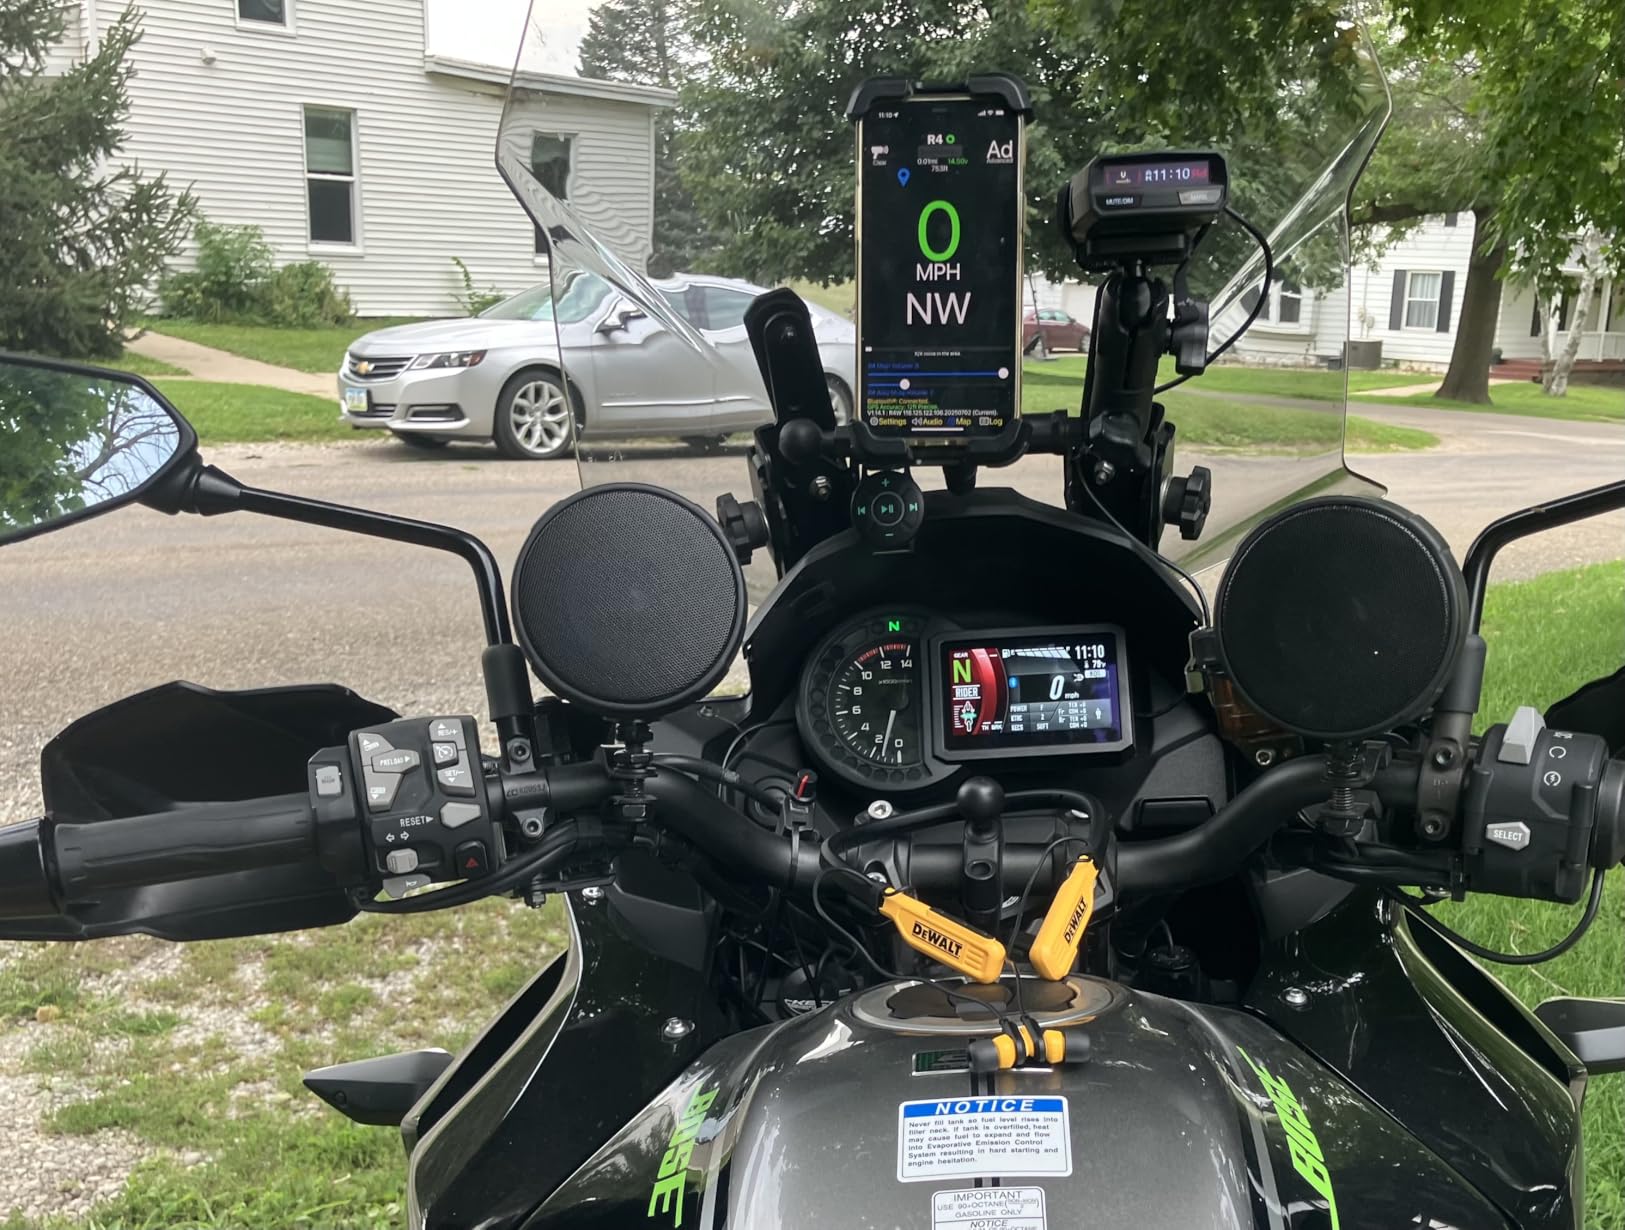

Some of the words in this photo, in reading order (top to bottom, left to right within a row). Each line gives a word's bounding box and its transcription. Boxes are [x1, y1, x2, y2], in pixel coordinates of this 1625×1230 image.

[927, 134, 944, 145] R4
[986, 139, 1013, 159] Ad
[918, 200, 961, 262] 0
[916, 263, 961, 281] MPH
[906, 292, 972, 325] NW
[879, 417, 907, 426] Settings
[922, 417, 943, 425] Audio
[955, 418, 972, 426] Map
[989, 418, 1003, 426] Log
[888, 621, 900, 632] N
[1075, 644, 1105, 659] 11:10
[880, 661, 892, 669] 12
[901, 660, 912, 668] 14
[861, 671, 873, 680] 10
[953, 659, 971, 684] N
[853, 687, 862, 696] 8
[1049, 675, 1065, 700] 0
[955, 687, 979, 698] RIDER
[1064, 692, 1080, 700] mph
[852, 706, 861, 714] 6
[861, 723, 870, 731] 4
[875, 735, 883, 744] 2
[895, 739, 903, 748] 0
[380, 758, 404, 767] PRELOAD
[400, 816, 426, 826] RESET
[1493, 830, 1523, 841] SELECT
[935, 1099, 1035, 1115] NOTICE
[927, 1141, 972, 1149] Evaporative
[938, 1157, 977, 1165] hesitation.
[954, 1190, 1023, 1202] IMPORTANT
[937, 1203, 953, 1211] USE
[955, 1209, 997, 1218] GASOLINE
[1000, 1208, 1023, 1216] ONLY
[970, 1219, 1008, 1228] NOTICE
